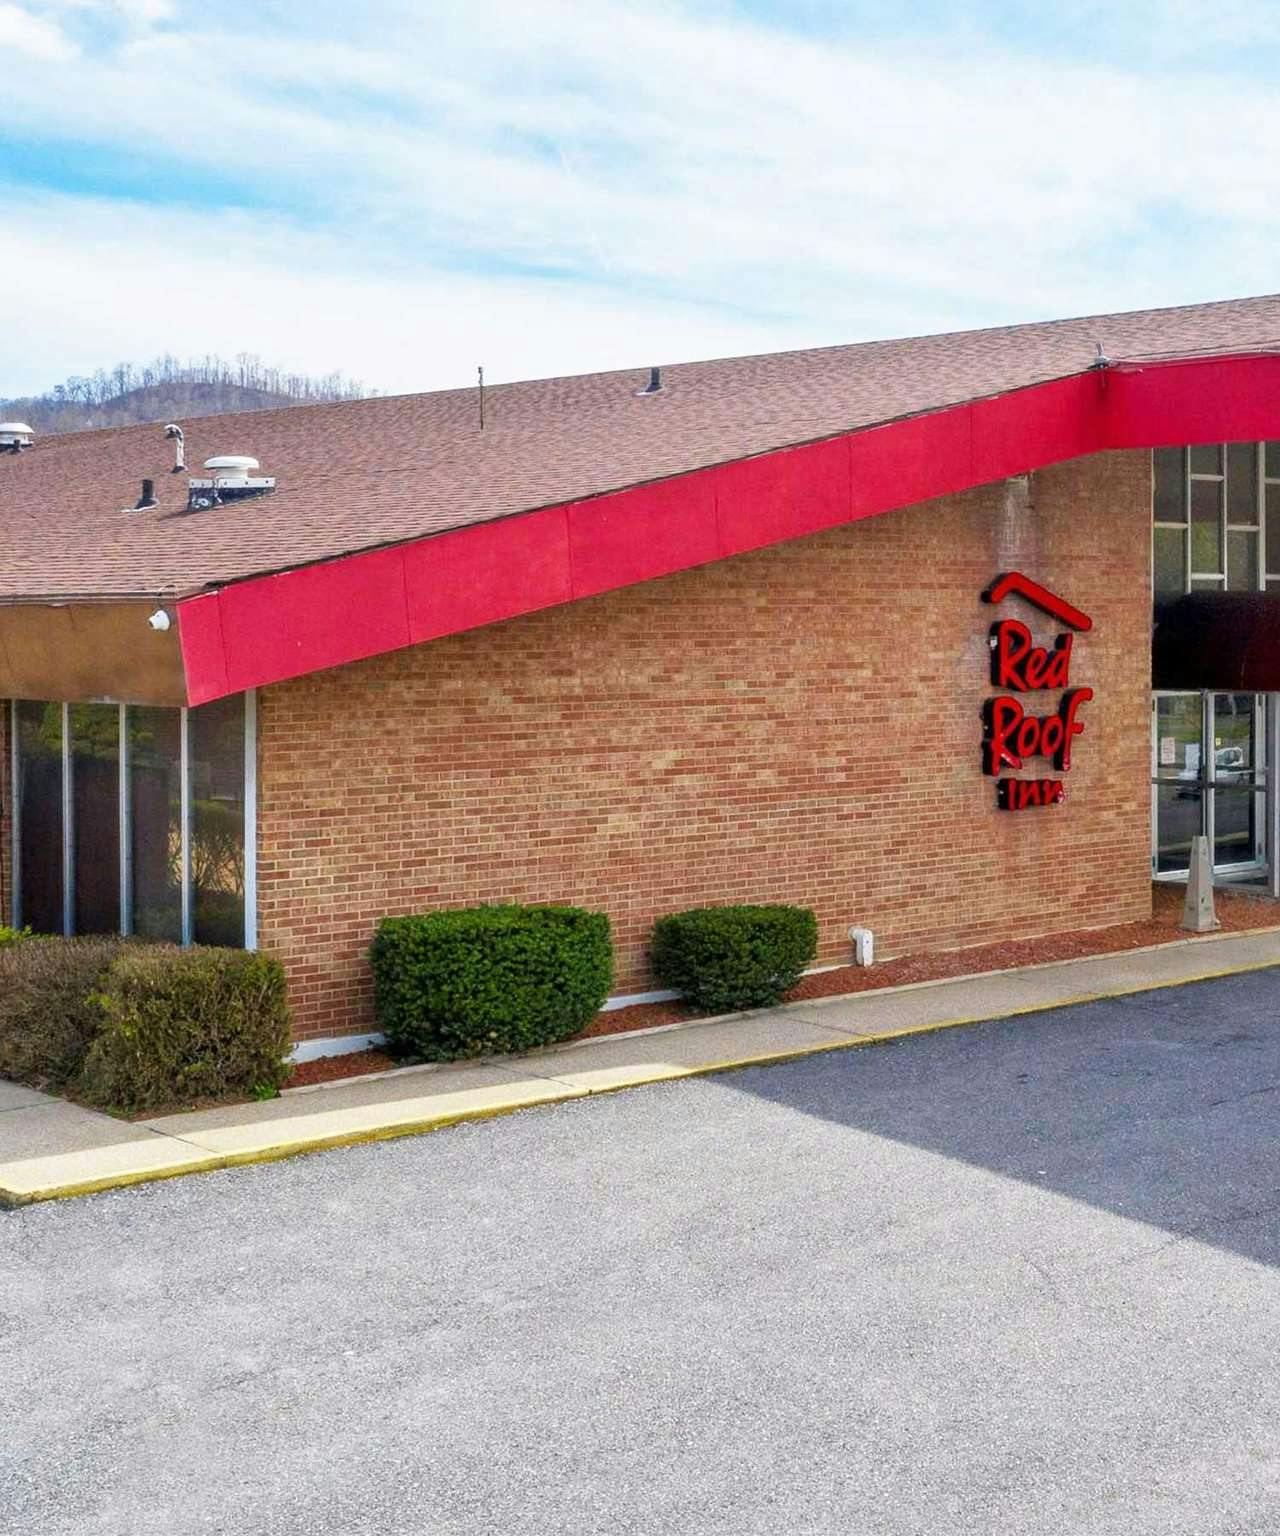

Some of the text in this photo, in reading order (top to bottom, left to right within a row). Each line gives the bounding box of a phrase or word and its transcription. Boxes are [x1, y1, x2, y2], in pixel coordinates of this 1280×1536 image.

[994, 618, 1073, 692] Red
[987, 687, 1093, 776] Roof
[1001, 778, 1065, 811] Inn
